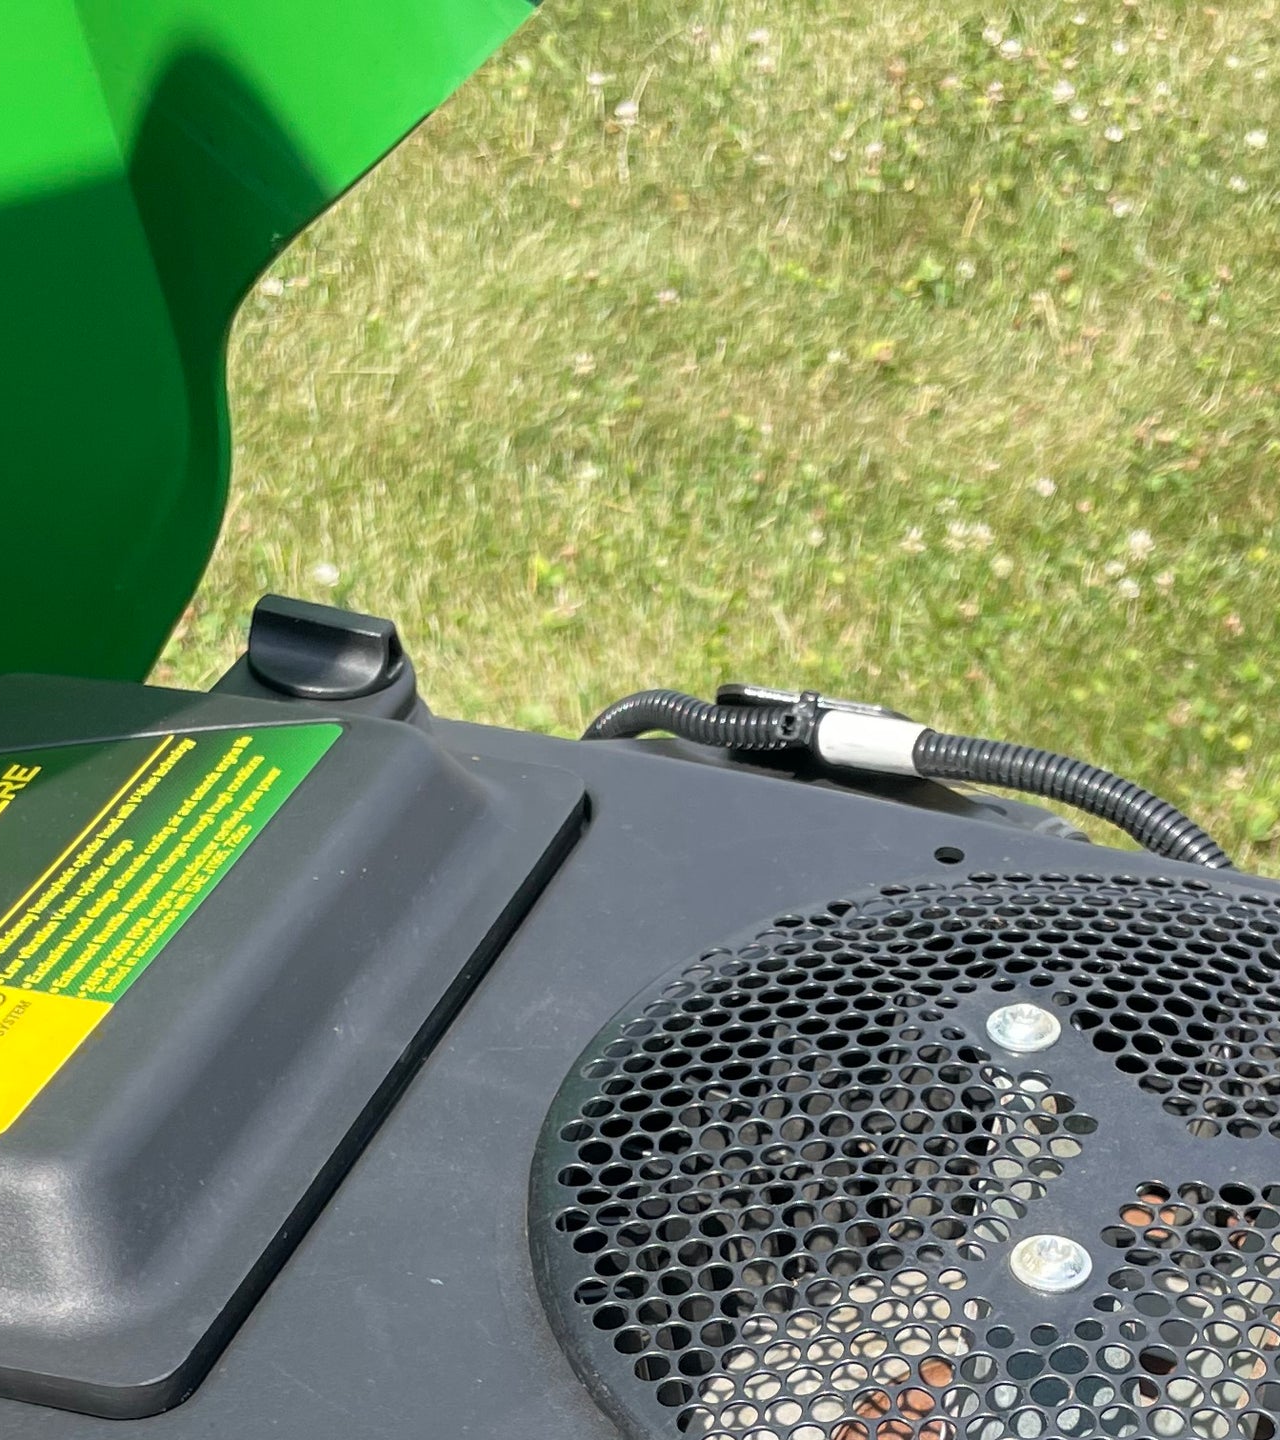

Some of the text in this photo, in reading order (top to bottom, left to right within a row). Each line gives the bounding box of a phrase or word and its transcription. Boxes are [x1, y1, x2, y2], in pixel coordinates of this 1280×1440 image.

[17, 920, 60, 959] vibration
[23, 940, 73, 984] Exclusive
[63, 916, 95, 942] hood
[85, 888, 120, 919] design
[50, 942, 102, 989] Enhanced
[121, 872, 164, 913] response
[125, 917, 155, 940] RPM
[147, 890, 181, 919] engine
